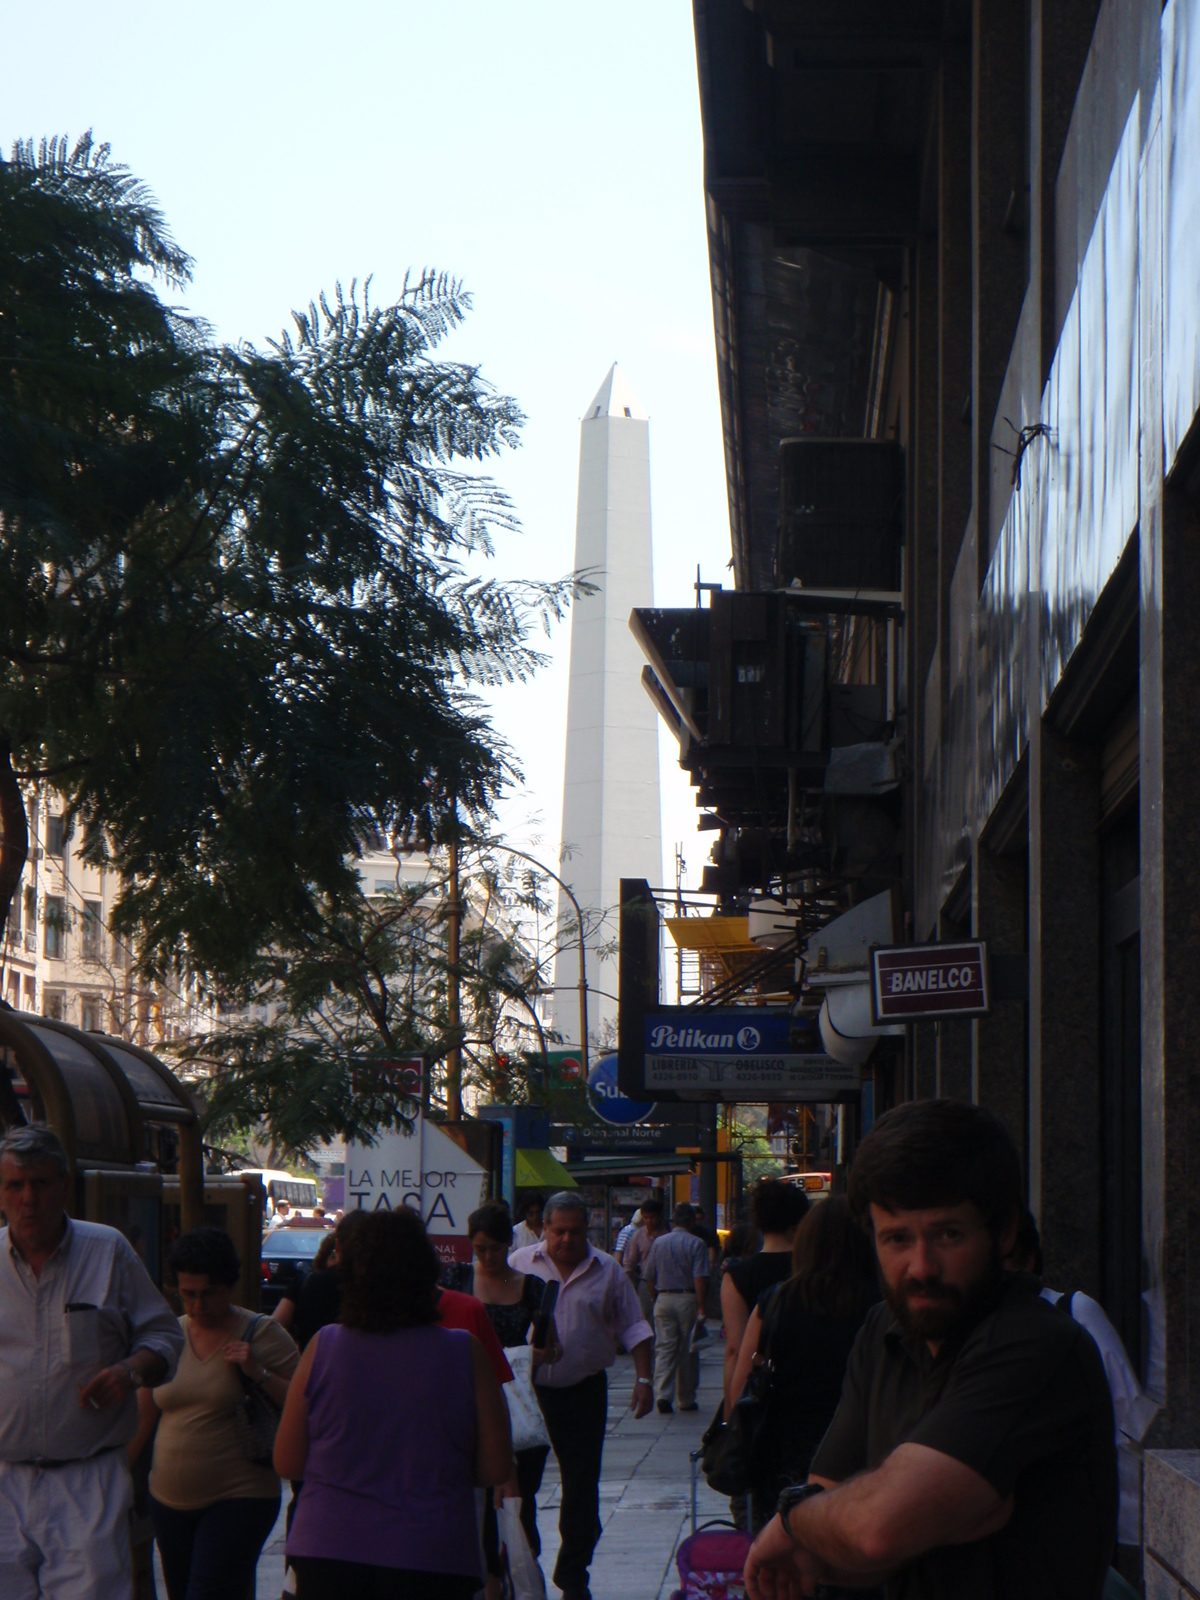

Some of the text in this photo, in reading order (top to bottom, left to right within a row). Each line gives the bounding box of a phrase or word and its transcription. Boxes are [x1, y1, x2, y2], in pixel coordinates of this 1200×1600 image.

[891, 967, 972, 992] BANELCO
[651, 1025, 734, 1048] Pelikan
[736, 1059, 785, 1070] OBELISCO
[583, 1128, 629, 1138] Dgnal
[632, 1128, 661, 1138] Norte
[349, 1170, 457, 1188] LA MEJOR
[350, 1192, 455, 1228] TASA
